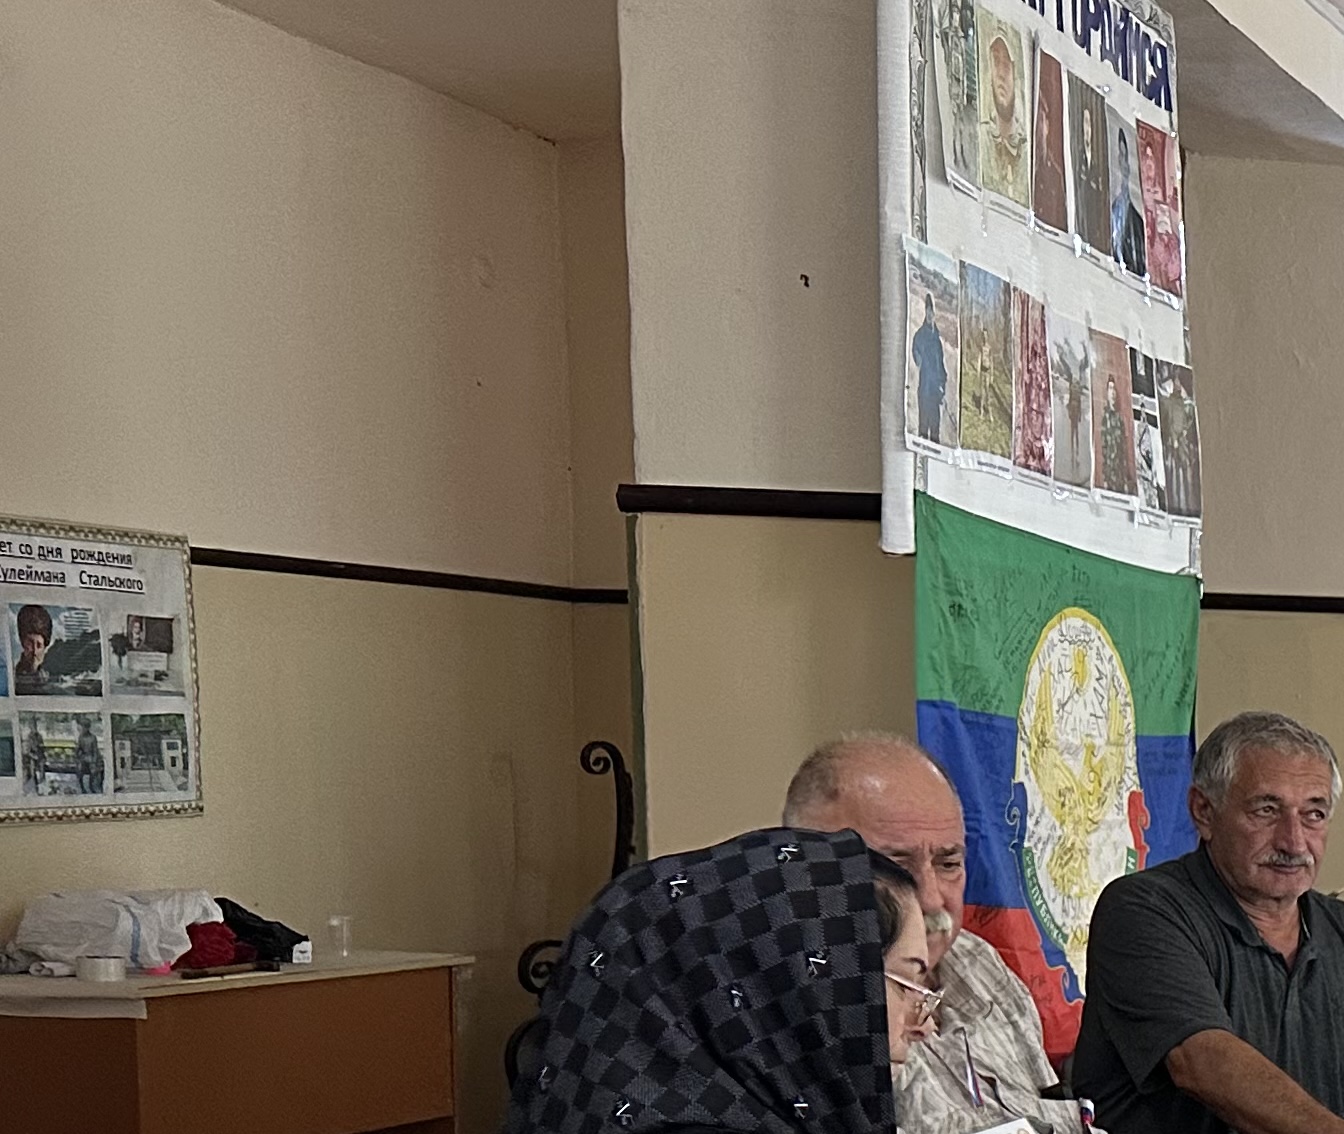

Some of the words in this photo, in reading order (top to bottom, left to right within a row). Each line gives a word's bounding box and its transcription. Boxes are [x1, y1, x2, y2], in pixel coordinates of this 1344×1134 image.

[19, 543, 33, 556] со
[37, 545, 63, 560] дня
[71, 548, 133, 566] рождения
[79, 569, 144, 591] Стальского
